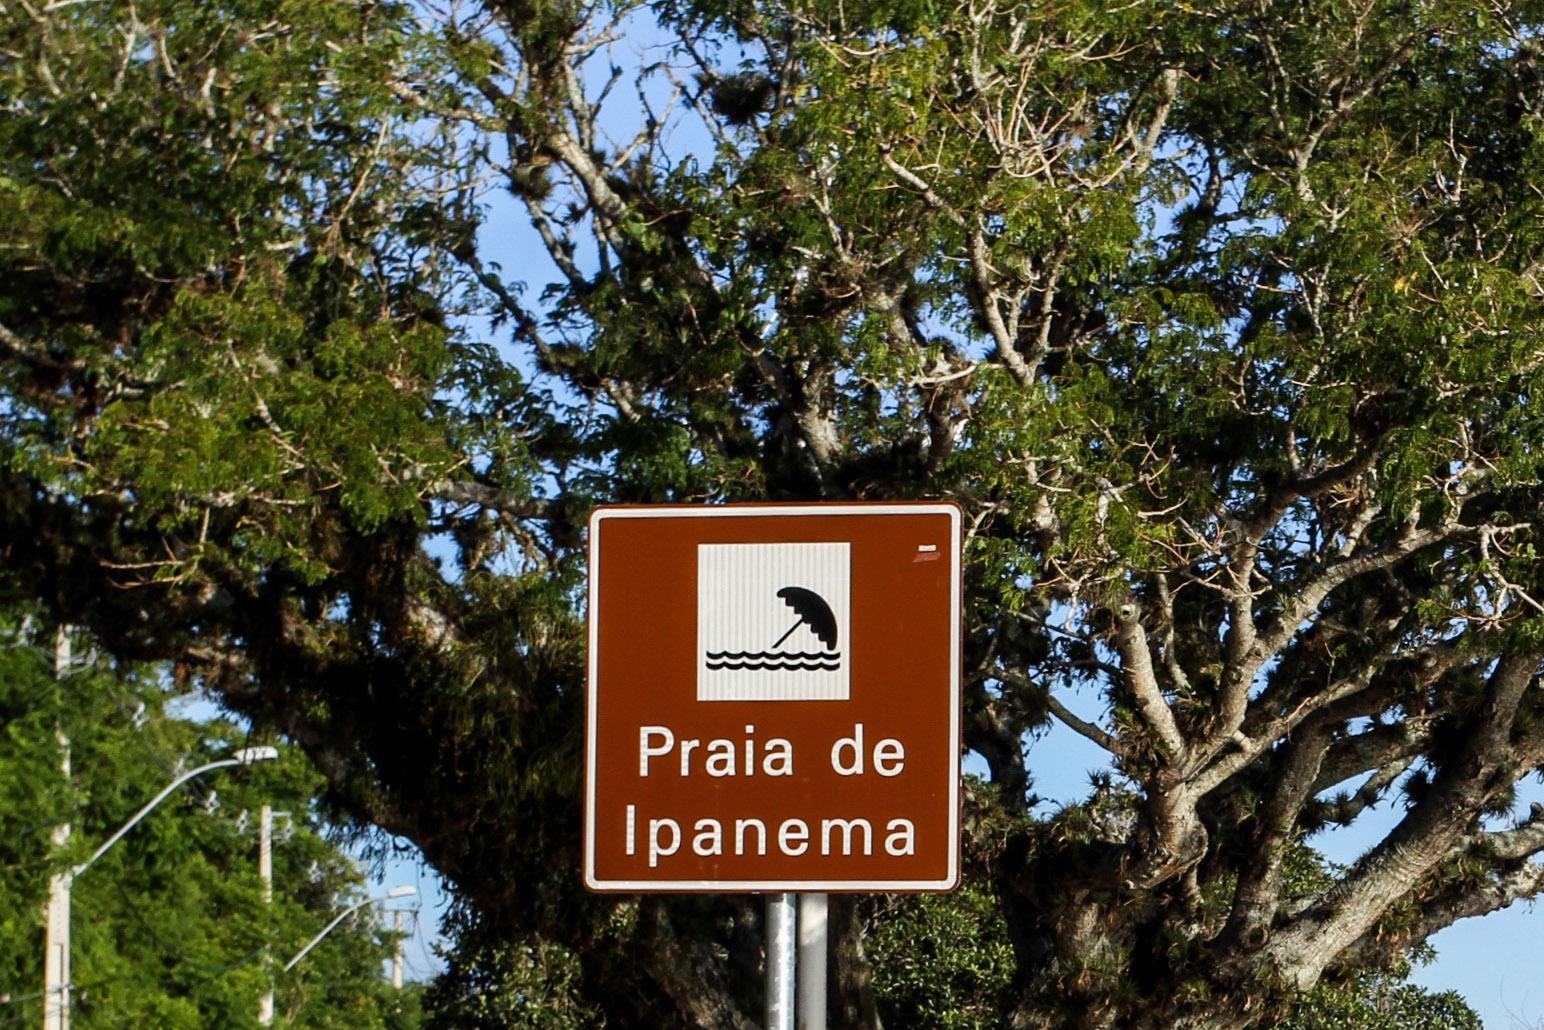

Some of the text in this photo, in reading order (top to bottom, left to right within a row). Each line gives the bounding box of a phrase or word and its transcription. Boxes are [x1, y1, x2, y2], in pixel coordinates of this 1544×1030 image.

[639, 723, 905, 777] Praia de
[625, 804, 916, 868] Ipanema
